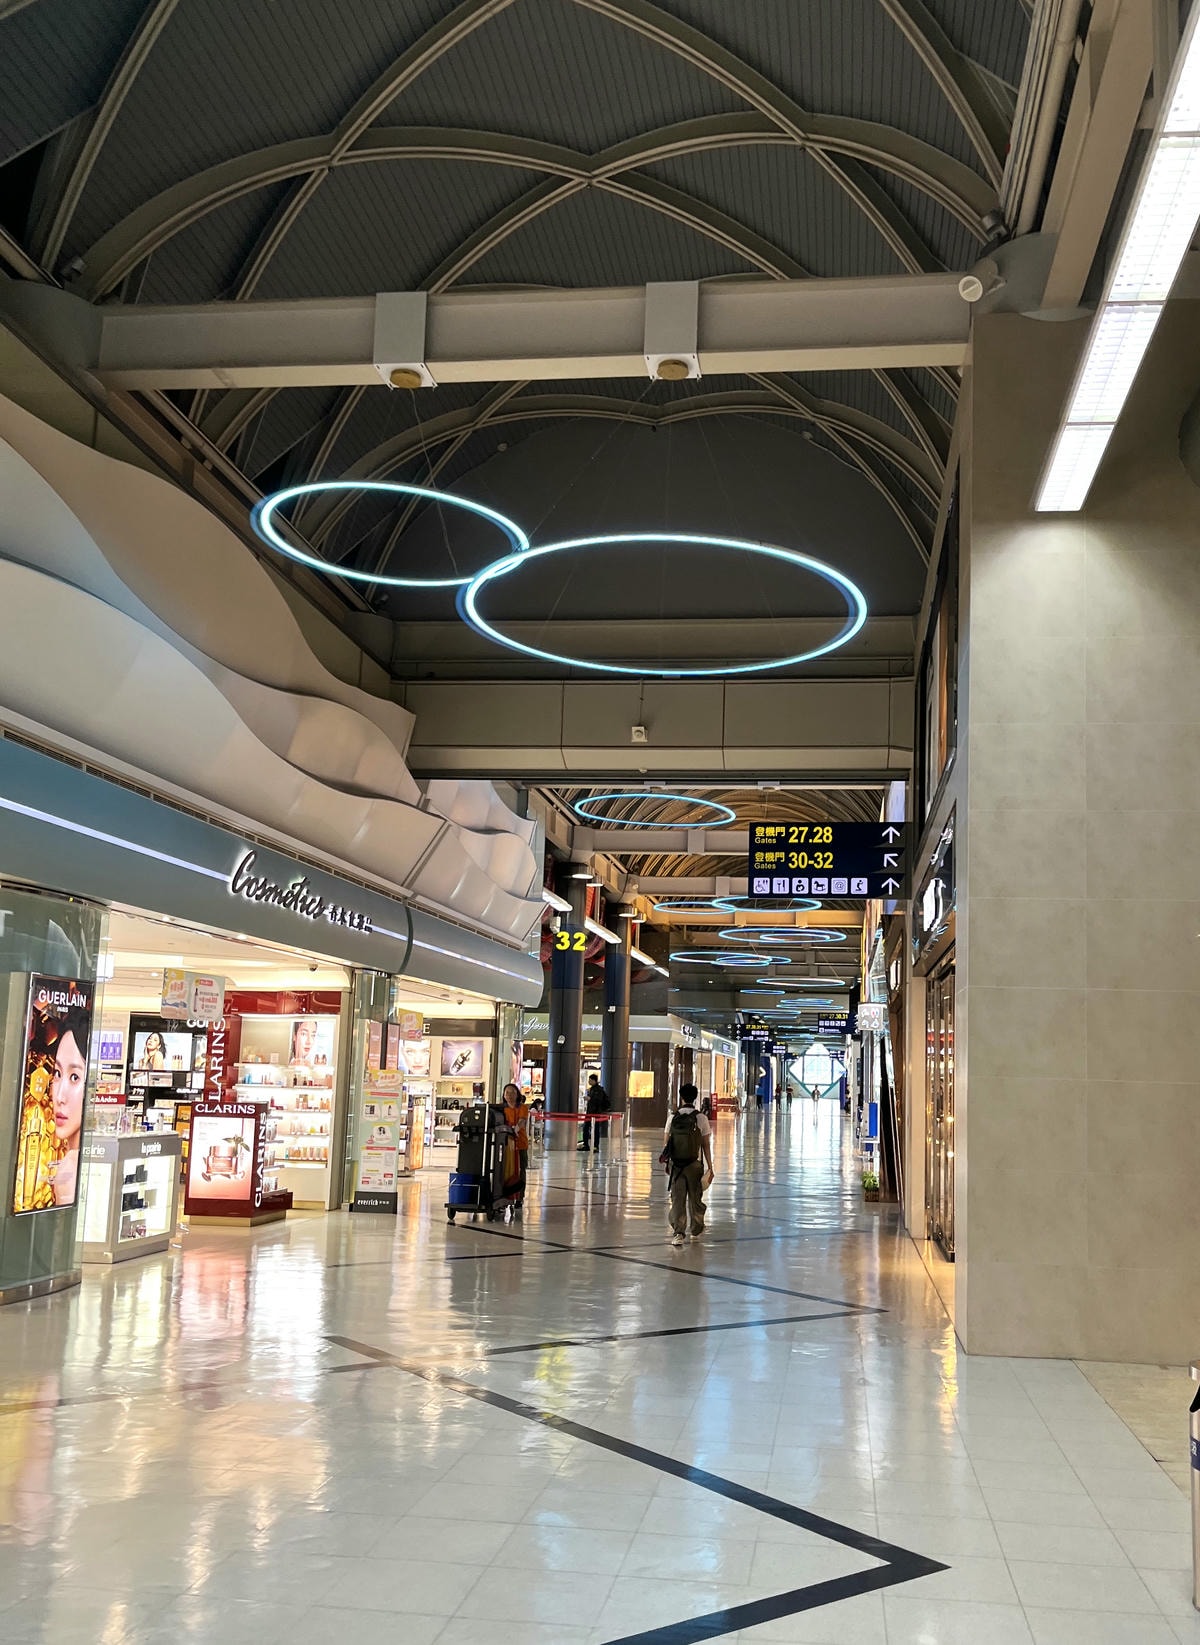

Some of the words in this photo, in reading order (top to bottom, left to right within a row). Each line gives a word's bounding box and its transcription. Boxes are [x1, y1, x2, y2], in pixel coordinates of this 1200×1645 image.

[755, 826, 786, 837] 登機門
[788, 826, 833, 843] 27.28
[753, 862, 777, 870] Gates
[754, 851, 785, 862] 登機門
[788, 851, 834, 869] 30-32
[231, 849, 326, 920] Cosmetics
[555, 931, 586, 951] 32
[38, 989, 87, 1008] GUERLAIN
[208, 1017, 226, 1103] LARINS
[194, 1103, 256, 1115] CLARINS
[82, 1144, 106, 1155] rairie
[254, 1112, 267, 1208] CLARINS
